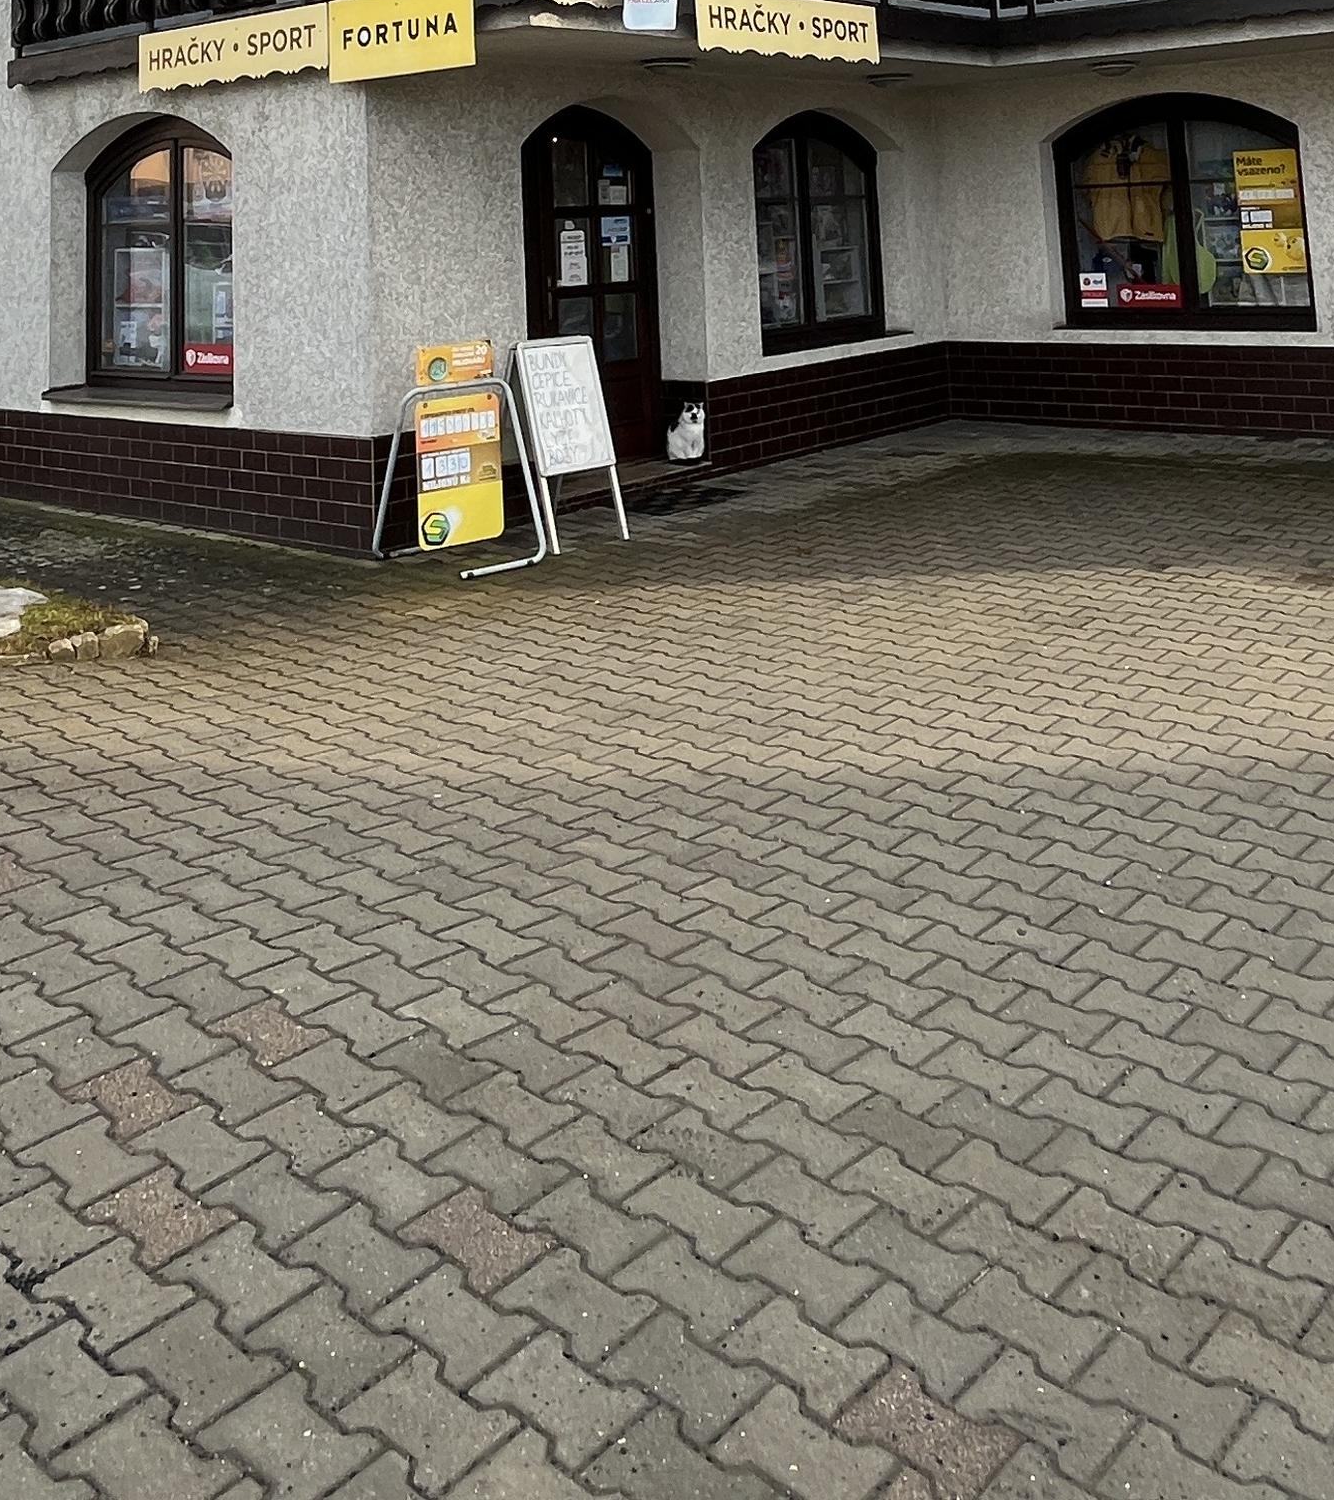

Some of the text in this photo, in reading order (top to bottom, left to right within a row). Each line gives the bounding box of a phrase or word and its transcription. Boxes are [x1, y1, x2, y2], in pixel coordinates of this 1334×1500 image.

[342, 12, 458, 50] FORTUNA
[708, 3, 869, 43] HRAČKY SPORT
[148, 24, 316, 71] HRAČKY SPORT
[1236, 156, 1262, 166] Máte
[1237, 164, 1285, 176] vsazeno?
